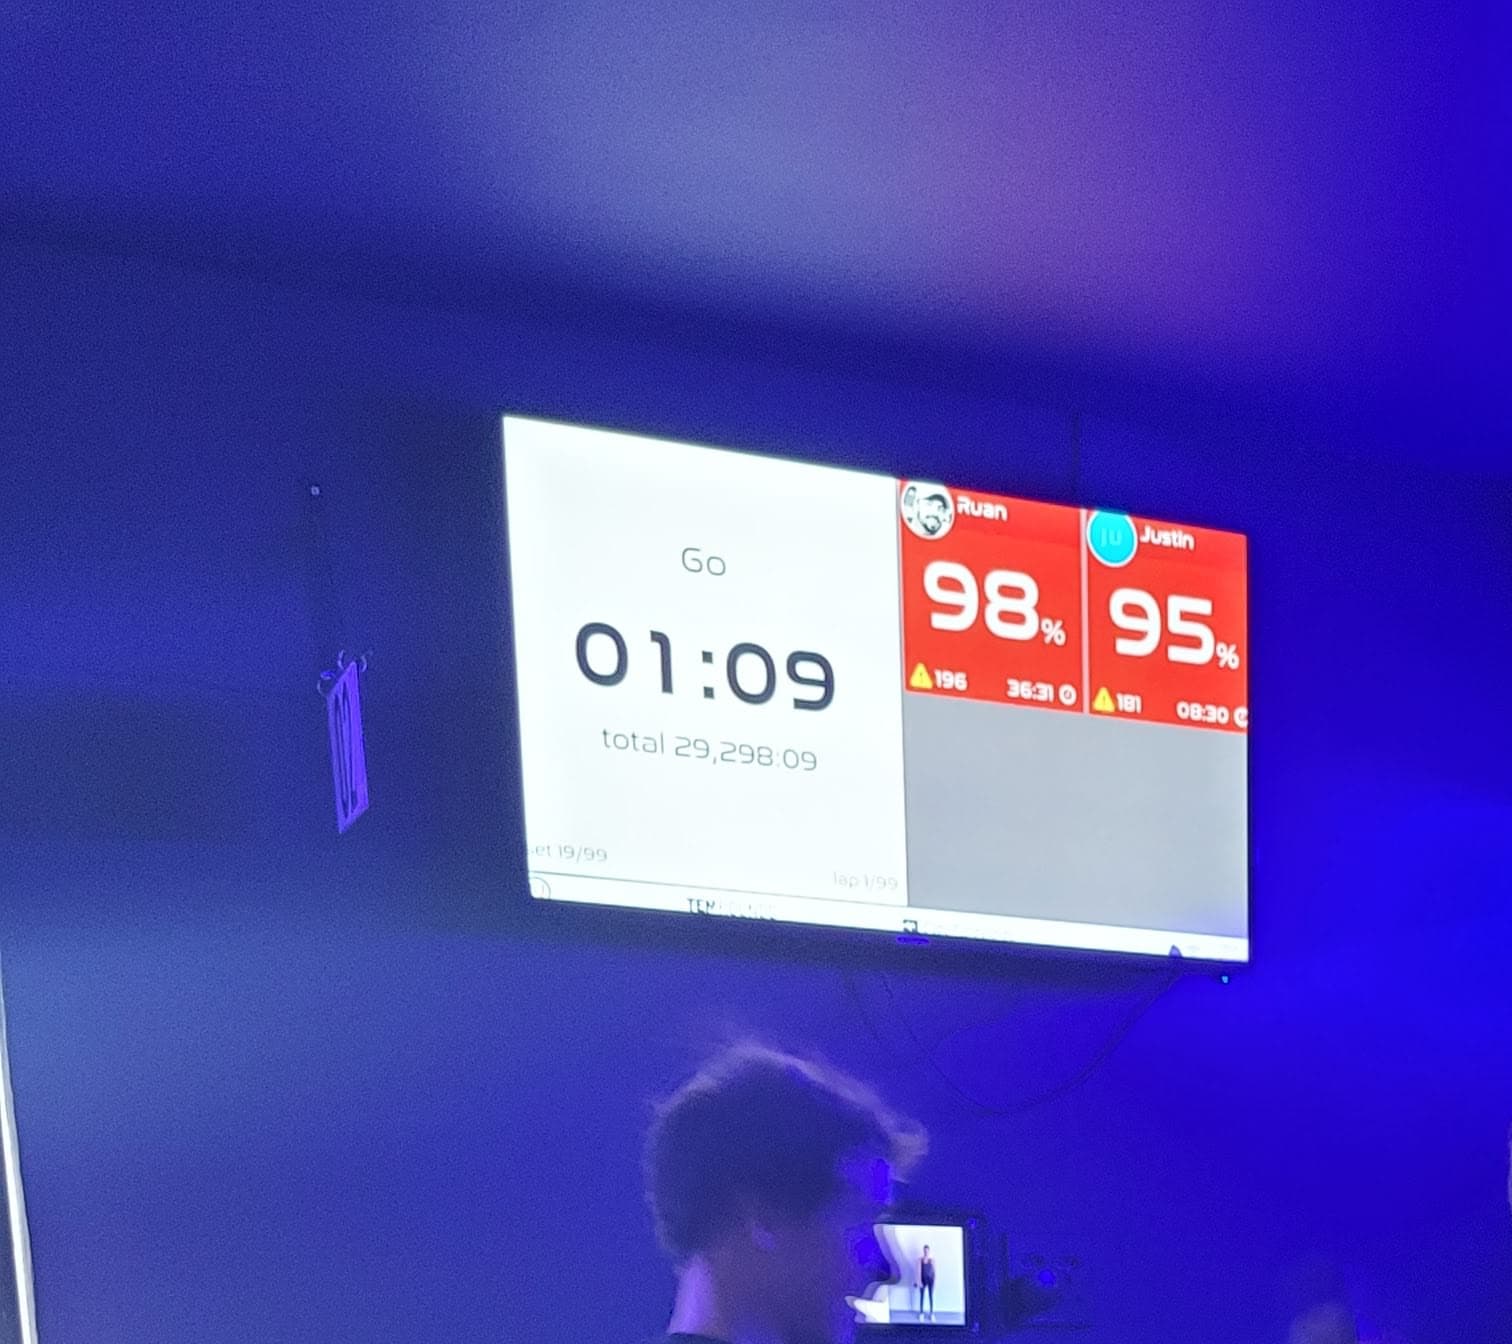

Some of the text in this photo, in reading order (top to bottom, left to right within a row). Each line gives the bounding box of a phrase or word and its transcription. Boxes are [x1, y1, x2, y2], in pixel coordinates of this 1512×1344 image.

[956, 495, 1008, 521] Ruan
[1139, 525, 1195, 550] Justin
[681, 547, 726, 577] Go
[922, 560, 1066, 646] 98%
[1108, 588, 1240, 670] 95%
[575, 622, 835, 711] 01:09
[934, 668, 967, 691] 196
[1007, 678, 1054, 702] 36:31
[1176, 701, 1229, 725] 08:30
[601, 728, 665, 755] total
